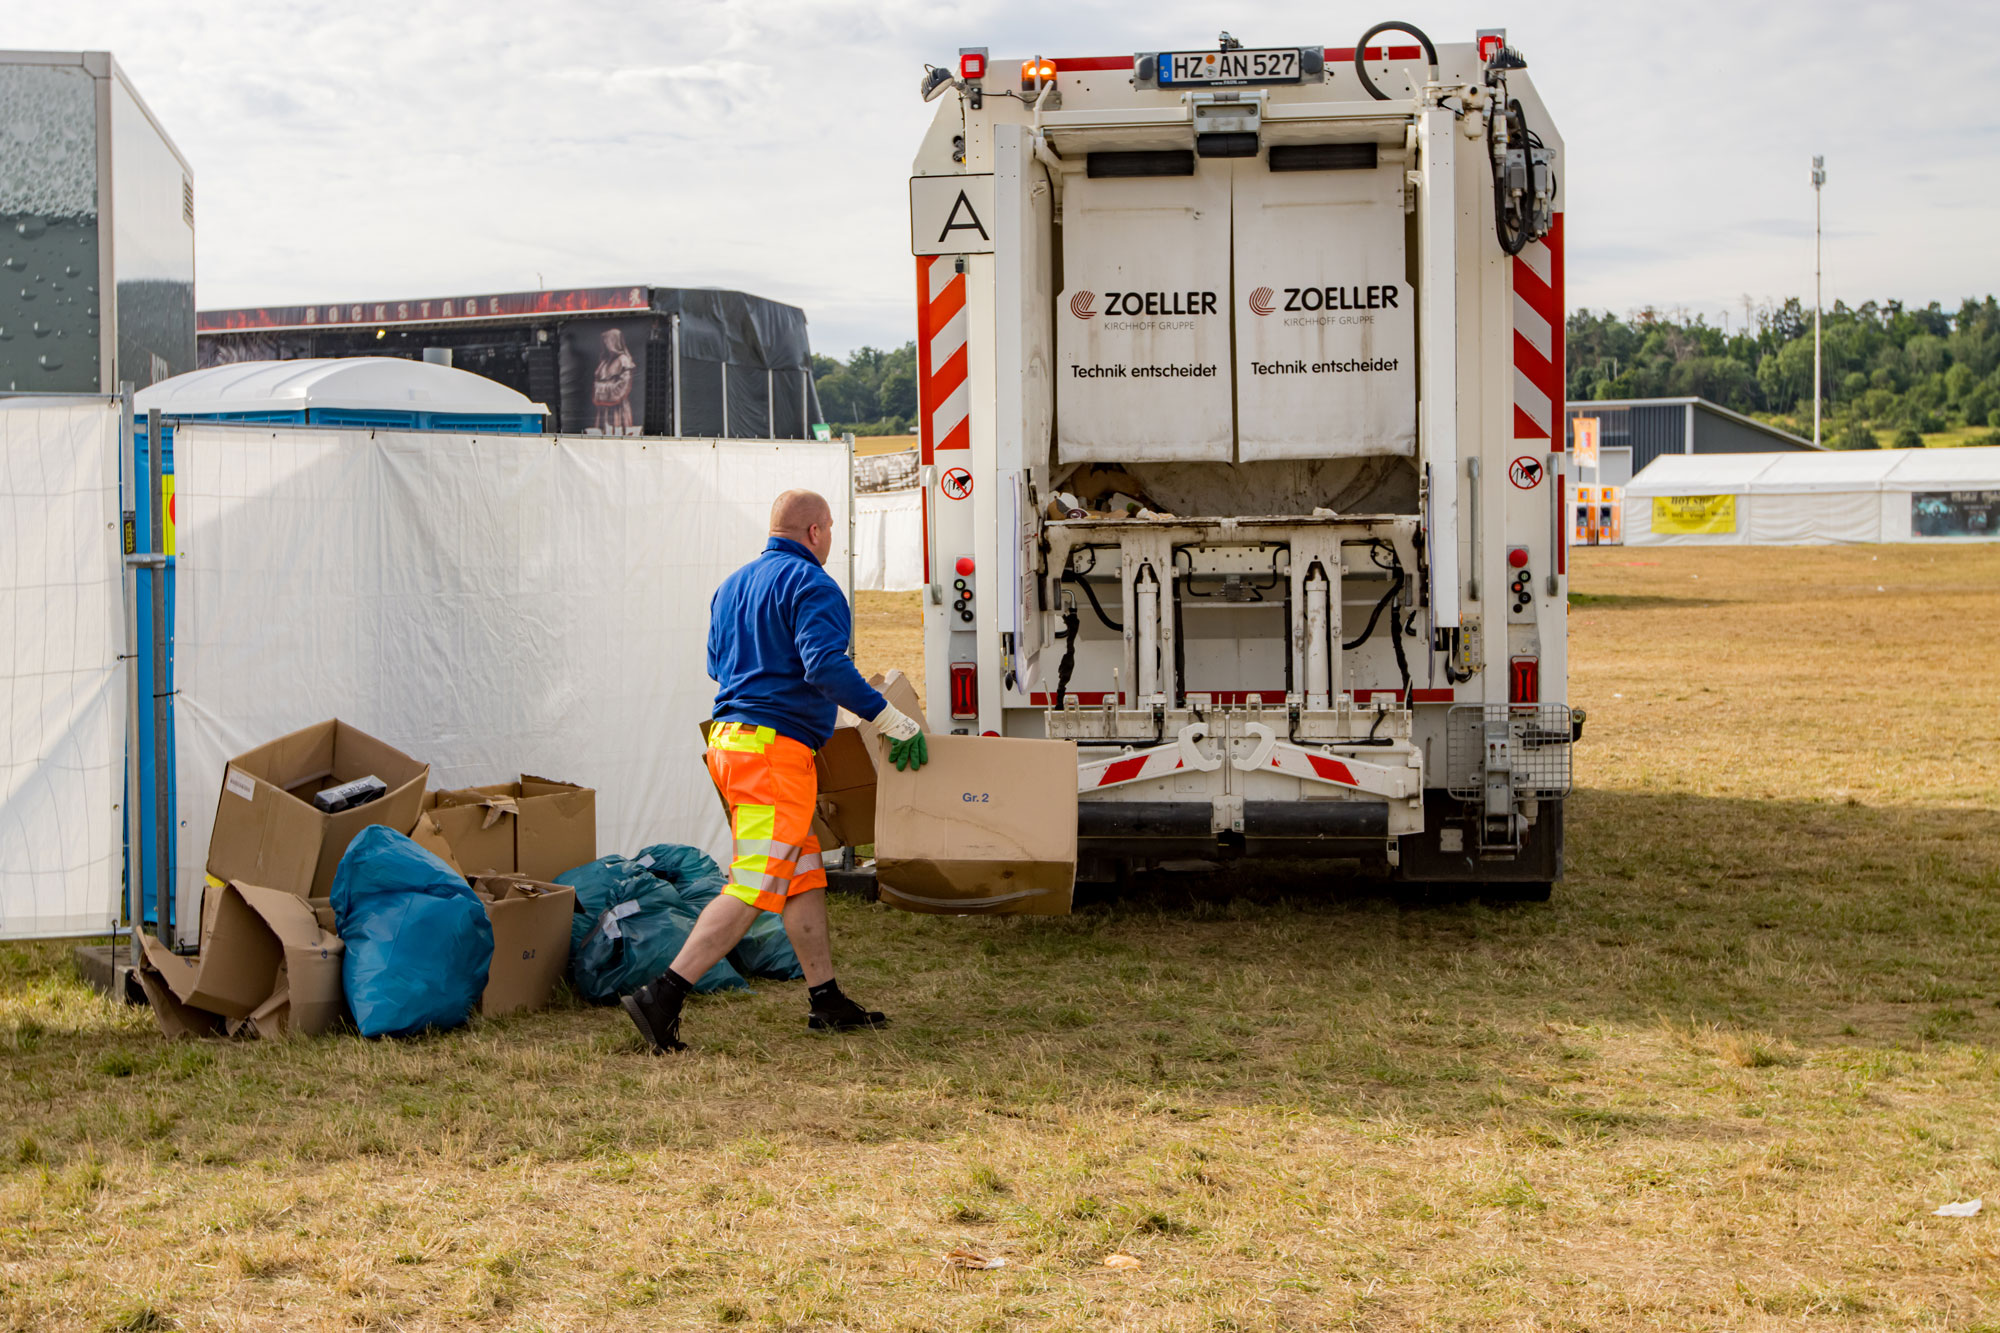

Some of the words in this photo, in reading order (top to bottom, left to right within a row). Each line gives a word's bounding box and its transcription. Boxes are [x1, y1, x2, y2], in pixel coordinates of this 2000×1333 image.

[1174, 56, 1204, 79] HZ
[1219, 54, 1248, 77] AN
[1253, 53, 1296, 76] 527
[938, 188, 990, 242] A
[1104, 291, 1217, 316] ZOELLER
[1283, 285, 1399, 312] ZOELLER
[305, 297, 499, 324] ROCKSTAGE
[1283, 316, 1336, 327] KIRCHHOFF
[1339, 315, 1375, 325] GRUPPE
[1104, 321, 1157, 331] KIRCHHOFF
[1158, 321, 1195, 330] GRUPPE
[1071, 363, 1127, 378] Technik
[1131, 363, 1217, 378] entscheidet
[1250, 359, 1308, 375] Technik
[1311, 357, 1399, 374] entscheidet
[962, 792, 980, 803] Gr.
[981, 792, 990, 803] 2
